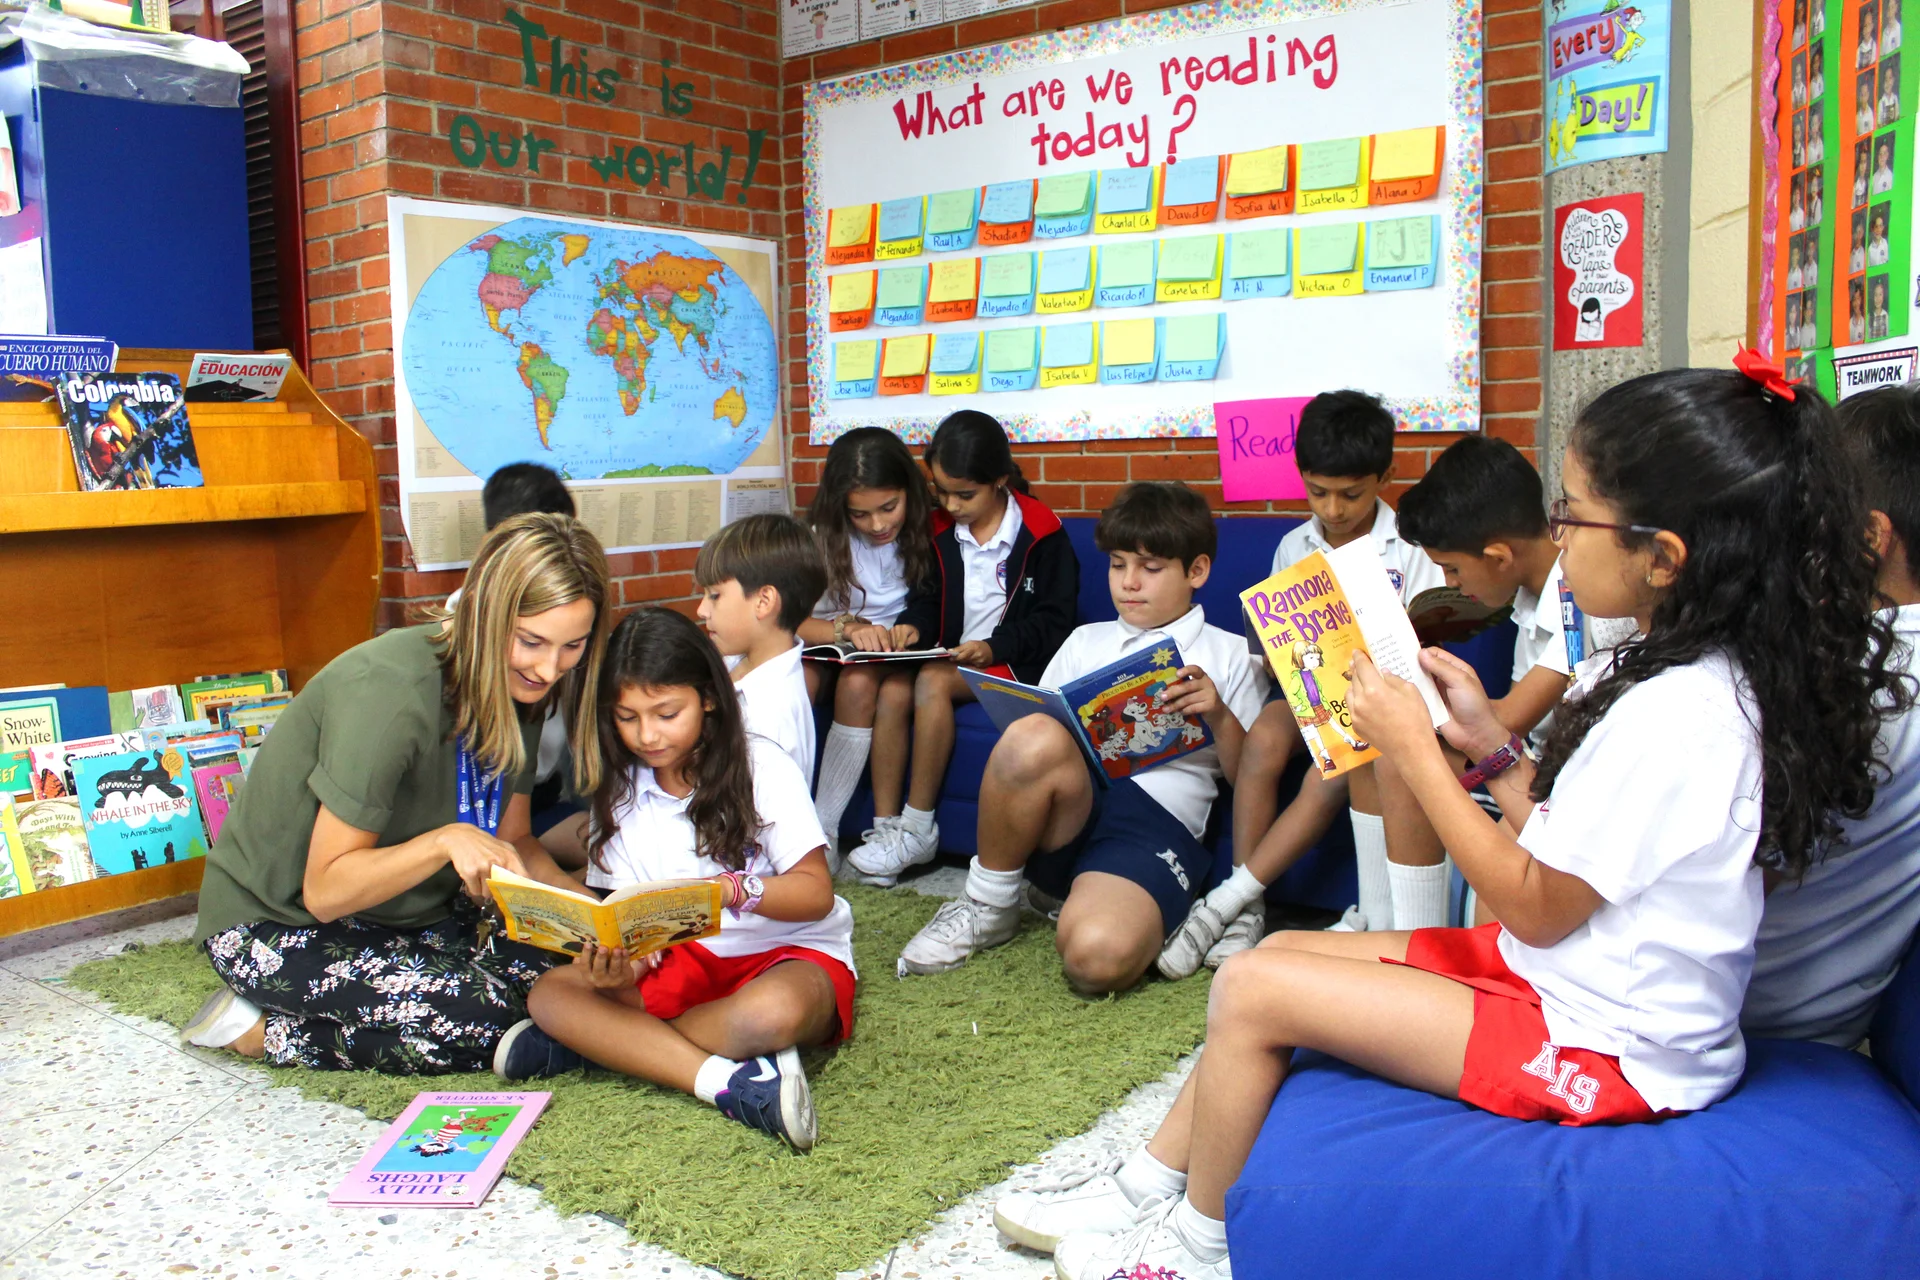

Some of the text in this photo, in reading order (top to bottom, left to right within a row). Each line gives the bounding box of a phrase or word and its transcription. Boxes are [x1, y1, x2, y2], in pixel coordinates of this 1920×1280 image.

[1552, 16, 1616, 70] Every
[504, 7, 695, 116] This is
[893, 33, 1338, 141] What are we reading
[1579, 83, 1648, 133] Day!
[450, 114, 768, 205] Our world!
[1301, 191, 1346, 208] Isabella
[1375, 186, 1408, 199] Alana
[1168, 206, 1199, 220] David
[1037, 222, 1077, 238] Alejandro
[1102, 215, 1136, 229] Chantal
[1582, 255, 1611, 277] laps
[1233, 280, 1249, 293] Ali
[1299, 279, 1335, 293] Victoria
[1571, 278, 1629, 302] parents
[1100, 289, 1137, 302] Ricardo
[981, 301, 1019, 315] Alejandro
[8, 344, 85, 354] ENCICLOPEDIA
[0, 354, 110, 371] CUERPO HUMANO
[198, 362, 284, 377] EDUCACIÓN
[1044, 367, 1080, 382] Isabella
[1106, 368, 1146, 381] Luis Felipe
[1164, 364, 1192, 378] Justin
[1846, 364, 1903, 387] TEAMWORK
[990, 376, 1014, 387] Diego
[67, 378, 176, 404] Colombia
[1247, 569, 1334, 628] Ramona
[1290, 599, 1352, 643] Brave
[1267, 628, 1295, 650] THE
[3, 717, 46, 731] Snow-
[7, 731, 52, 746] White
[0, 764, 19, 783] ET
[87, 796, 193, 822] WHALE IN THE SKY
[30, 817, 53, 827] Days
[120, 824, 173, 840] by Anne Siberell
[1520, 1040, 1600, 1114] AIS
[366, 1173, 468, 1183] LAUGHS
[371, 1184, 444, 1195] LILLY
